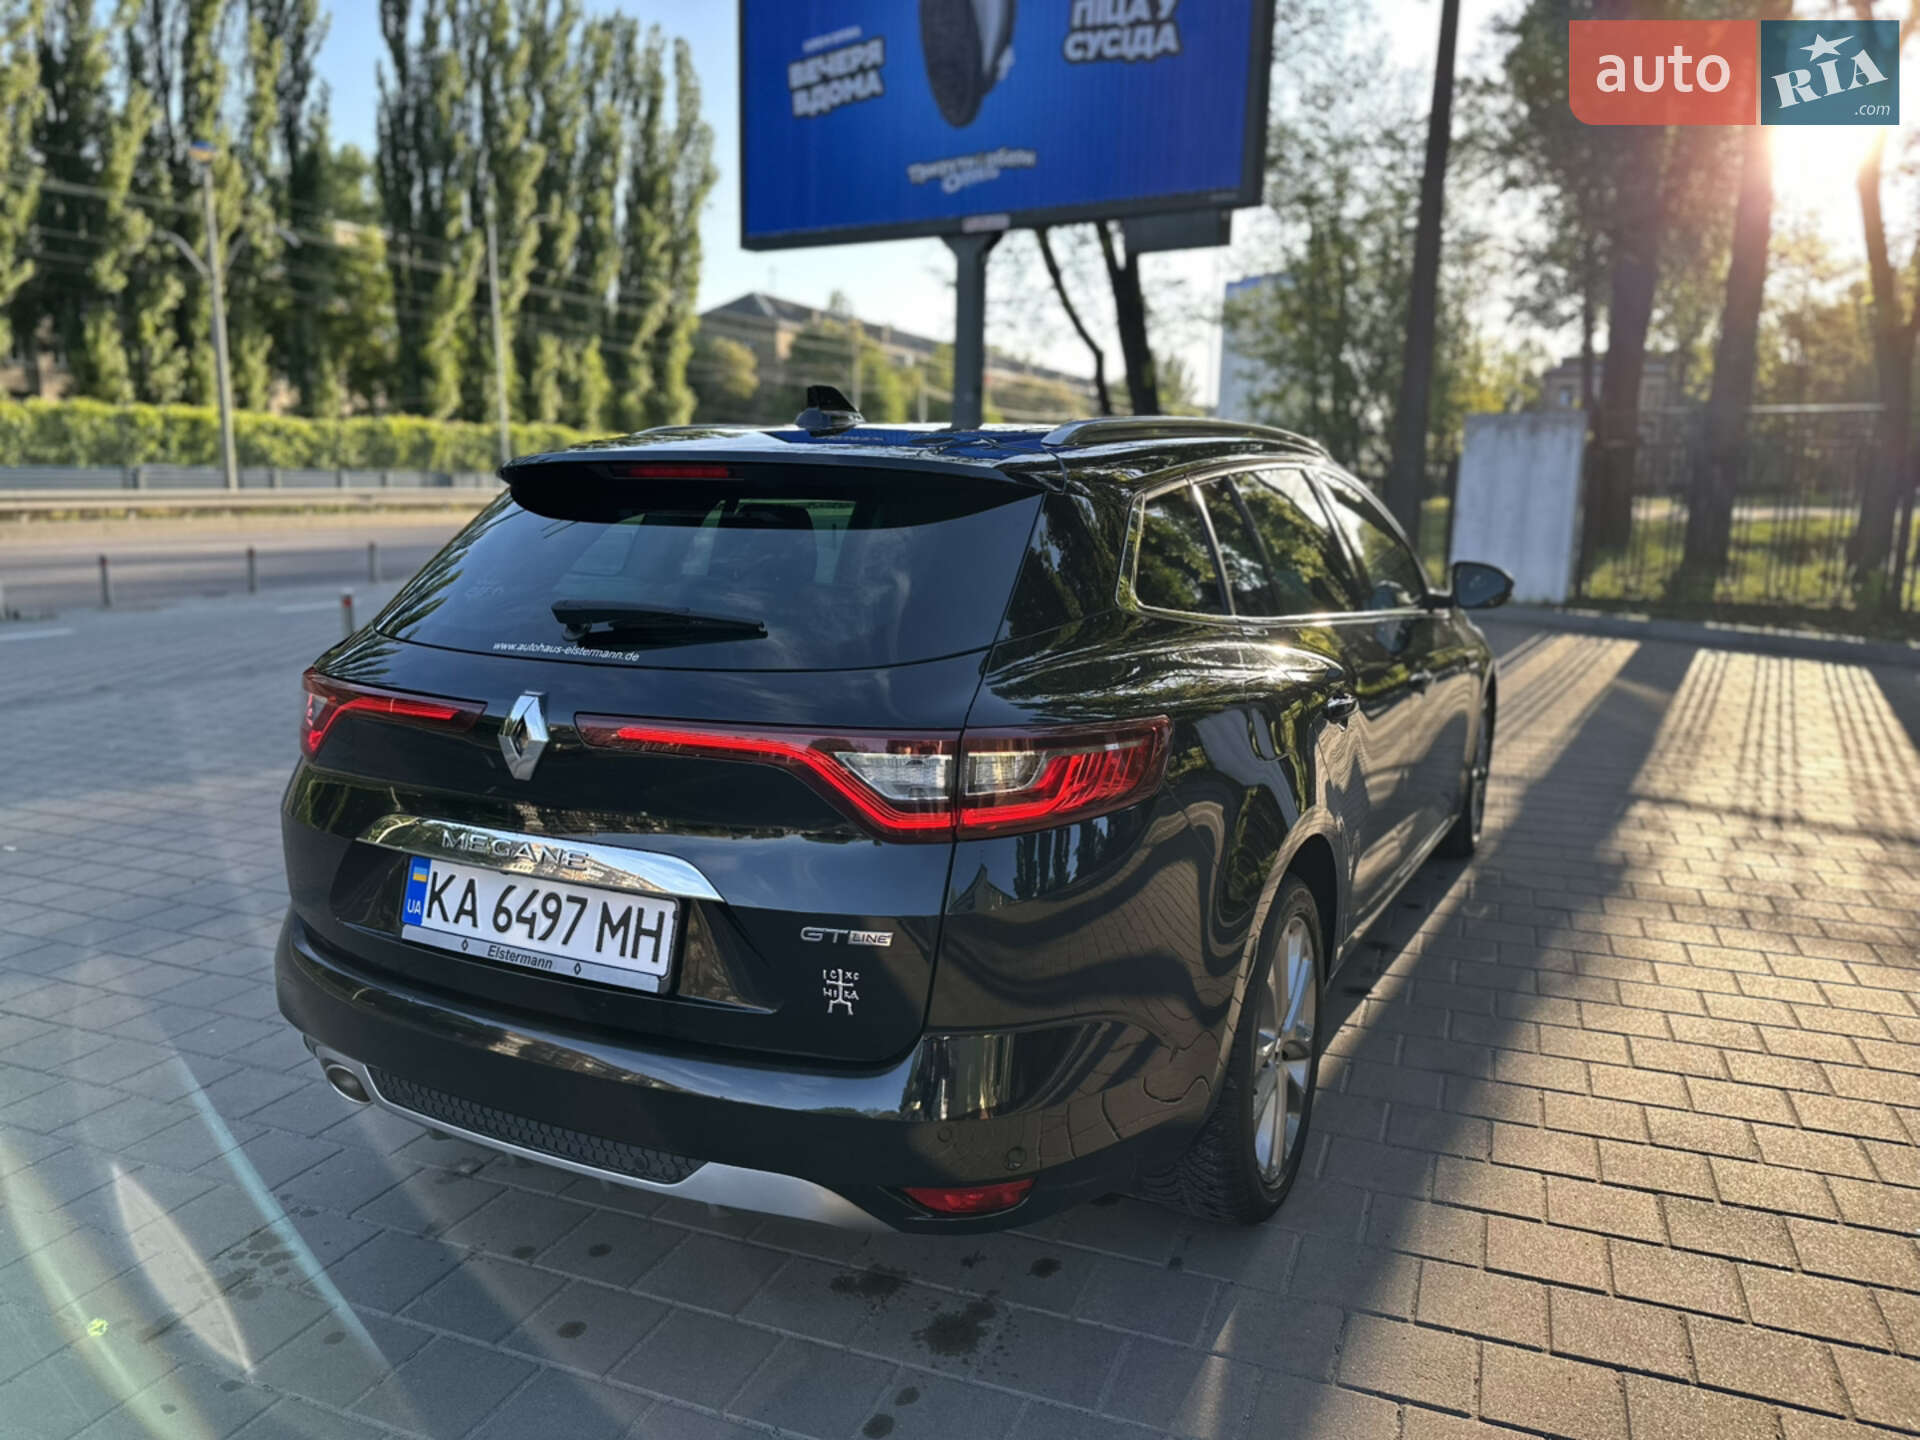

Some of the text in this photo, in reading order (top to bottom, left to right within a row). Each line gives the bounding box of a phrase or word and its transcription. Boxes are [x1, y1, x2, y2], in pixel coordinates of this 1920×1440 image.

[1064, 22, 1179, 60] СУСІДА
[789, 39, 884, 89] ВЕЧЕРЯ
[793, 69, 882, 117] ВДОМА
[493, 641, 640, 662] www.autohaus-elstermann.de
[441, 830, 590, 871] MEGANE
[406, 898, 422, 916] UA
[425, 871, 665, 964] KA 6497 MH
[801, 926, 849, 944] GT
[487, 945, 553, 970] Elstermann
